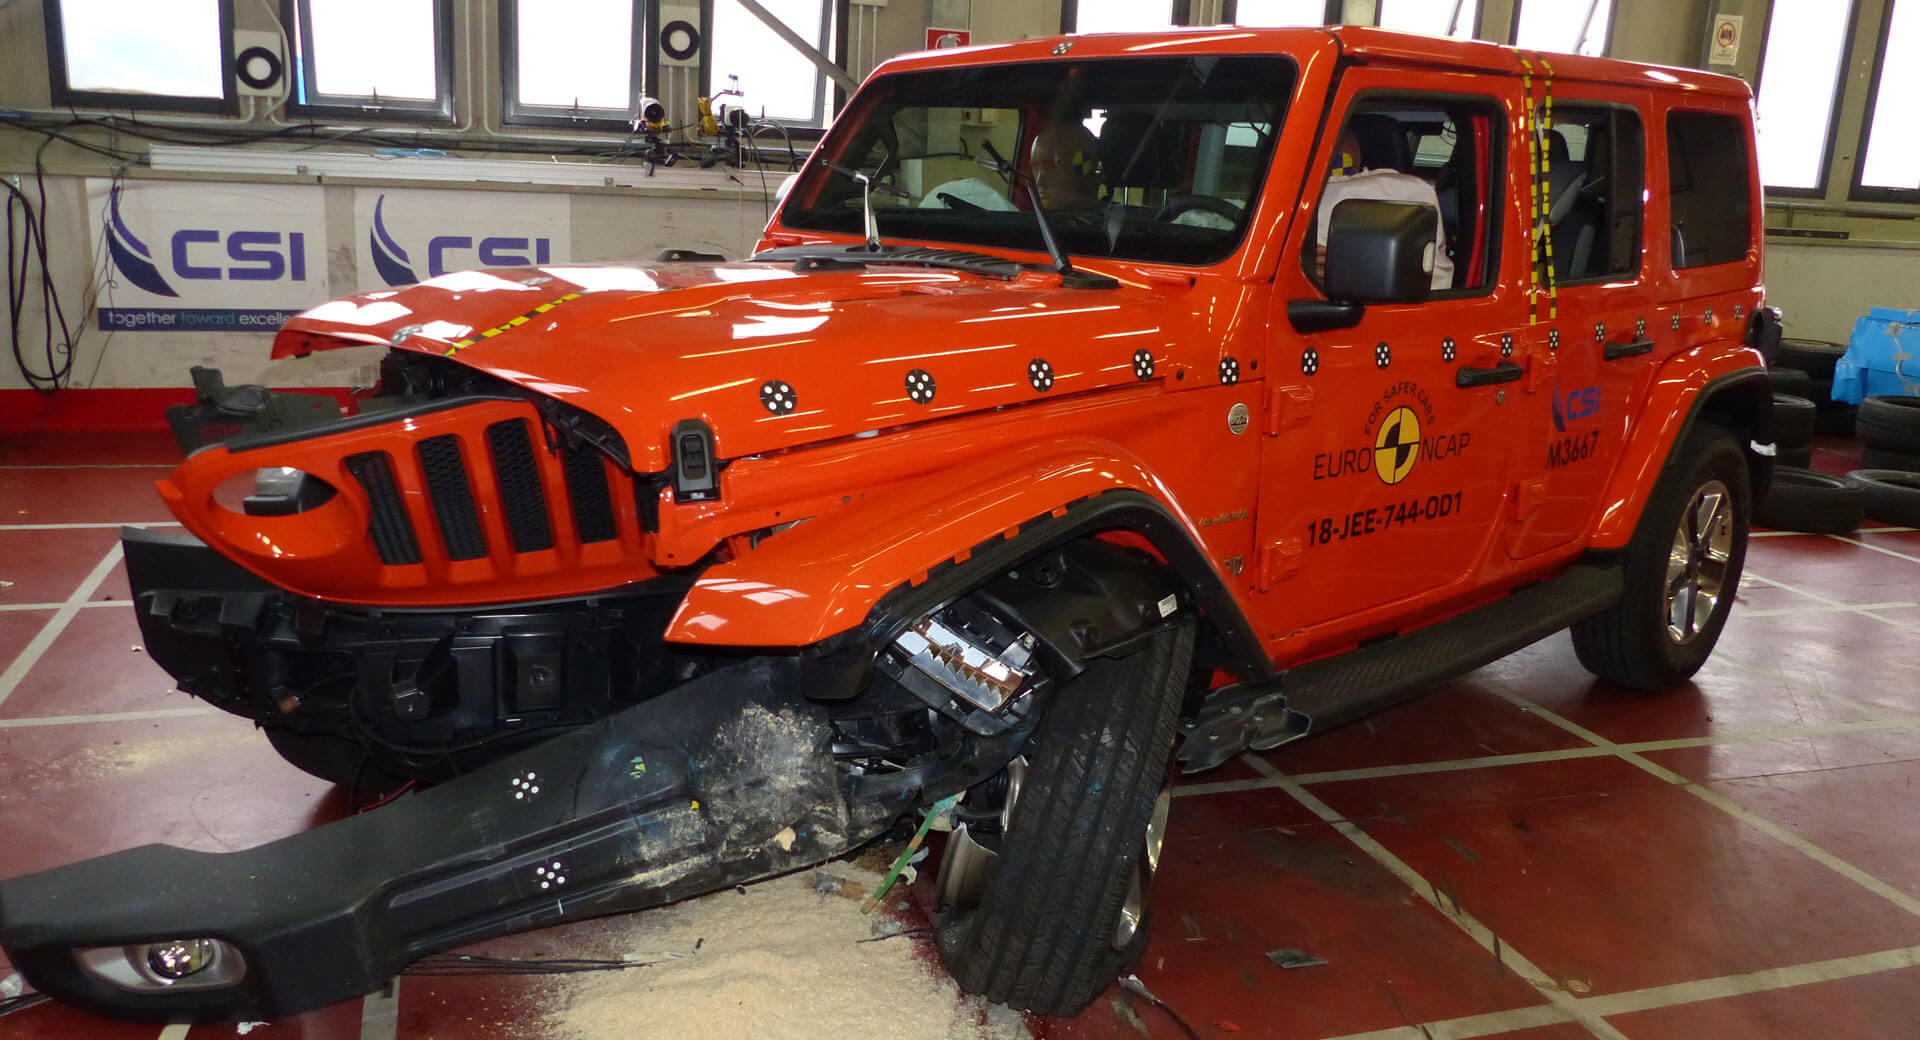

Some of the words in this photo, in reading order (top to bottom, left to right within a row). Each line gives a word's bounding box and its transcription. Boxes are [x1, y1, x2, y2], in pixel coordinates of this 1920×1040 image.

[171, 229, 306, 281] CSI
[108, 311, 177, 327] together
[181, 312, 235, 325] toward
[1364, 401, 1383, 435] FOR
[1384, 382, 1417, 403] SAFER
[1417, 389, 1434, 426] CARS
[1567, 385, 1602, 421] CSI
[1313, 447, 1372, 480] EURO
[1421, 432, 1471, 462] NCAP
[1546, 430, 1599, 471] M3667
